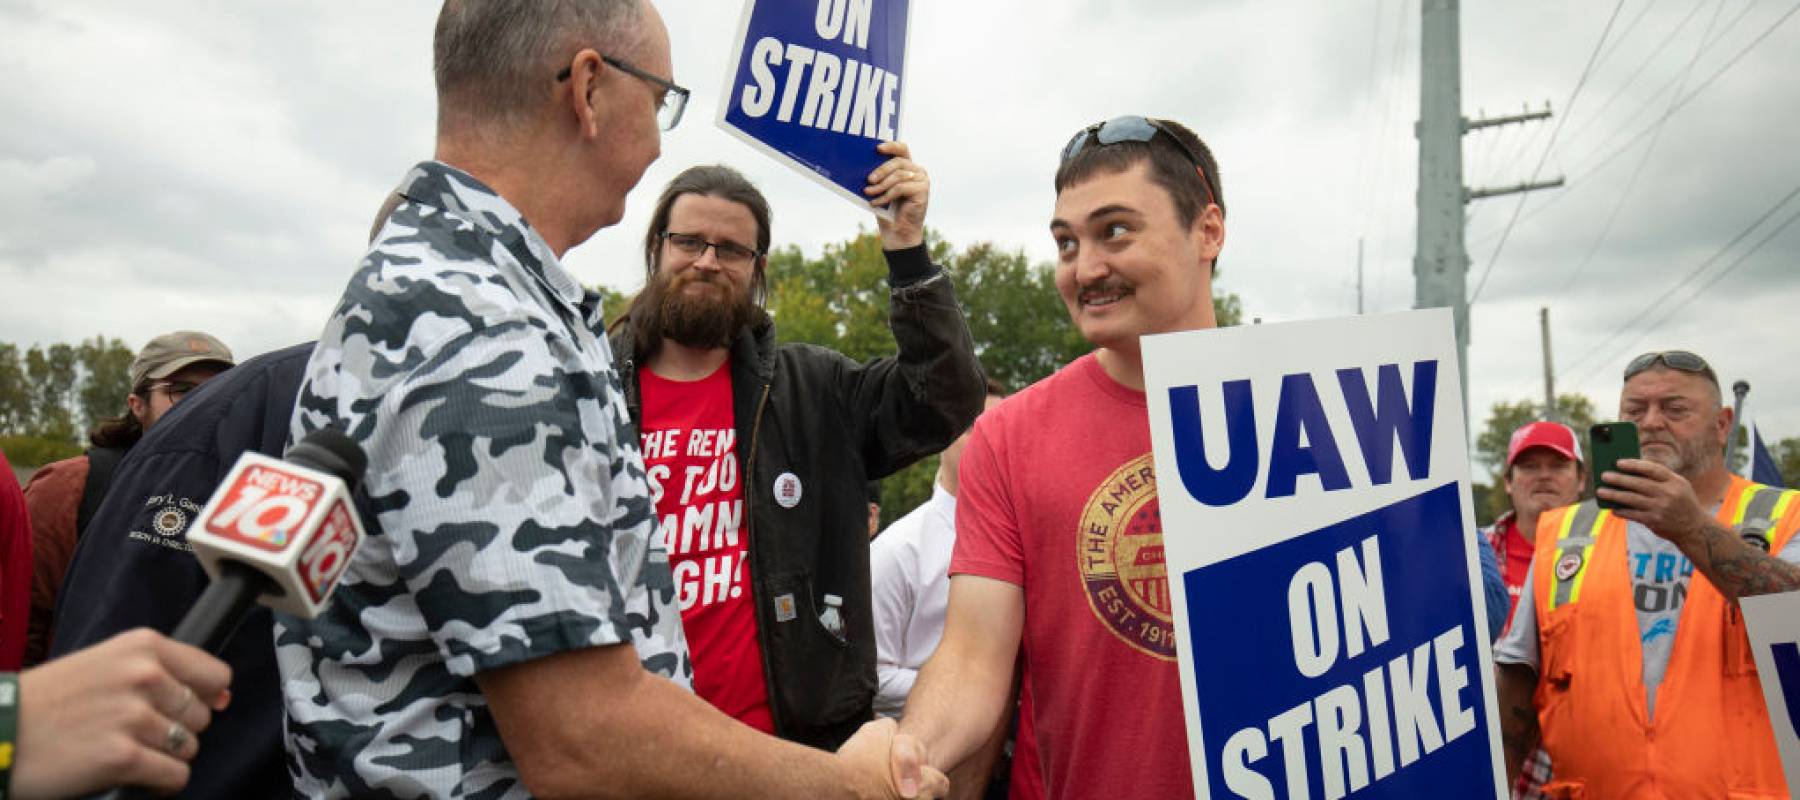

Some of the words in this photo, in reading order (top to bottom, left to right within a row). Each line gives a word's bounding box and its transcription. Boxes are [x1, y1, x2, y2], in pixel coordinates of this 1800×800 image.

[815, 0, 871, 49] ON
[741, 37, 899, 141] STRIKE
[687, 428, 736, 457] REN
[1168, 359, 1438, 507] UAW
[247, 466, 320, 500] NEWS
[647, 464, 670, 504] S
[212, 485, 308, 538] 10
[657, 500, 744, 556] AMN
[1088, 522, 1109, 570] THE
[1100, 467, 1156, 518] AMER
[673, 551, 749, 612] GH!
[1098, 585, 1136, 631] EST.
[1287, 534, 1390, 679] ON
[1222, 625, 1476, 799] STRIKE
